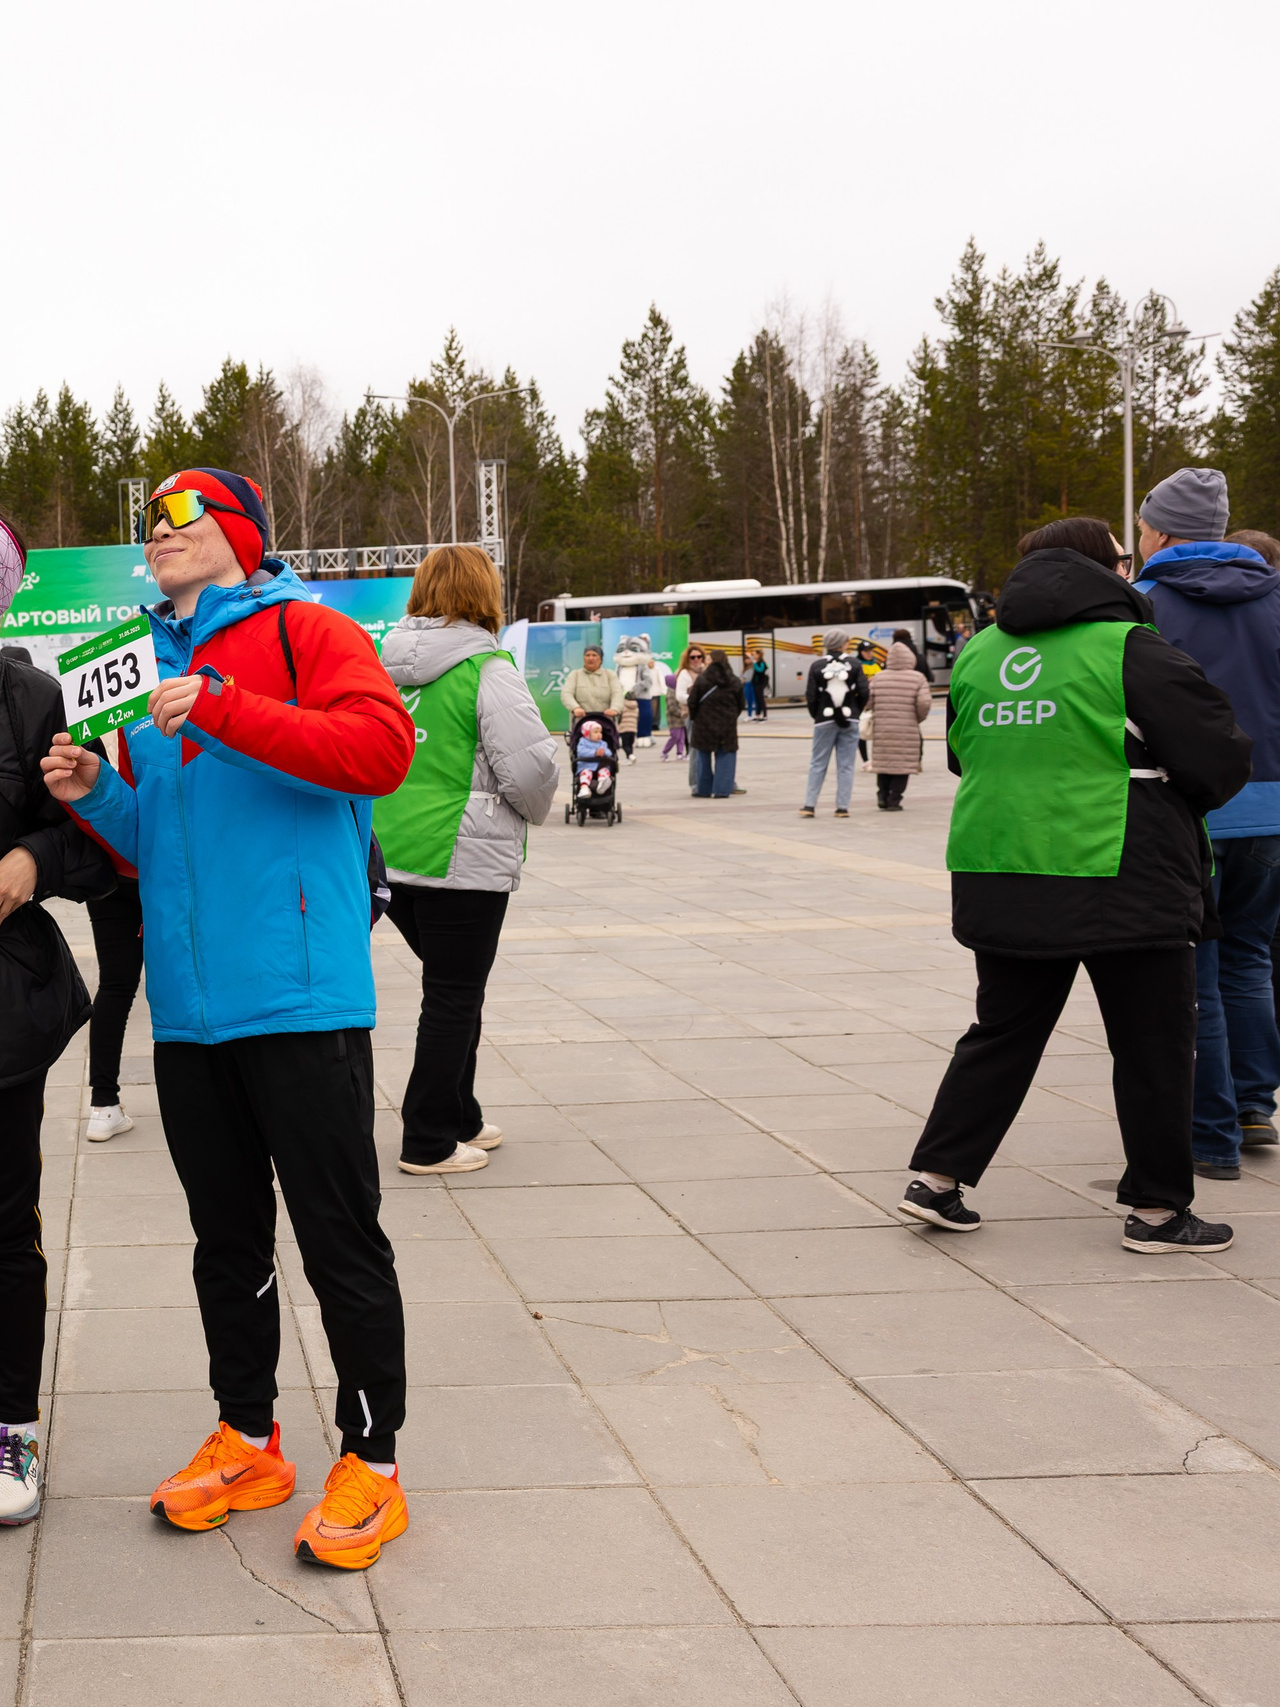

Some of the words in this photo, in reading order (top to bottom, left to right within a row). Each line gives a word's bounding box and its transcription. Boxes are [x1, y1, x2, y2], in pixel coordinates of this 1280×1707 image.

[3, 605, 101, 628] АРТОВЫЙ
[77, 652, 141, 709] 4153
[978, 700, 1057, 727] СБЕР
